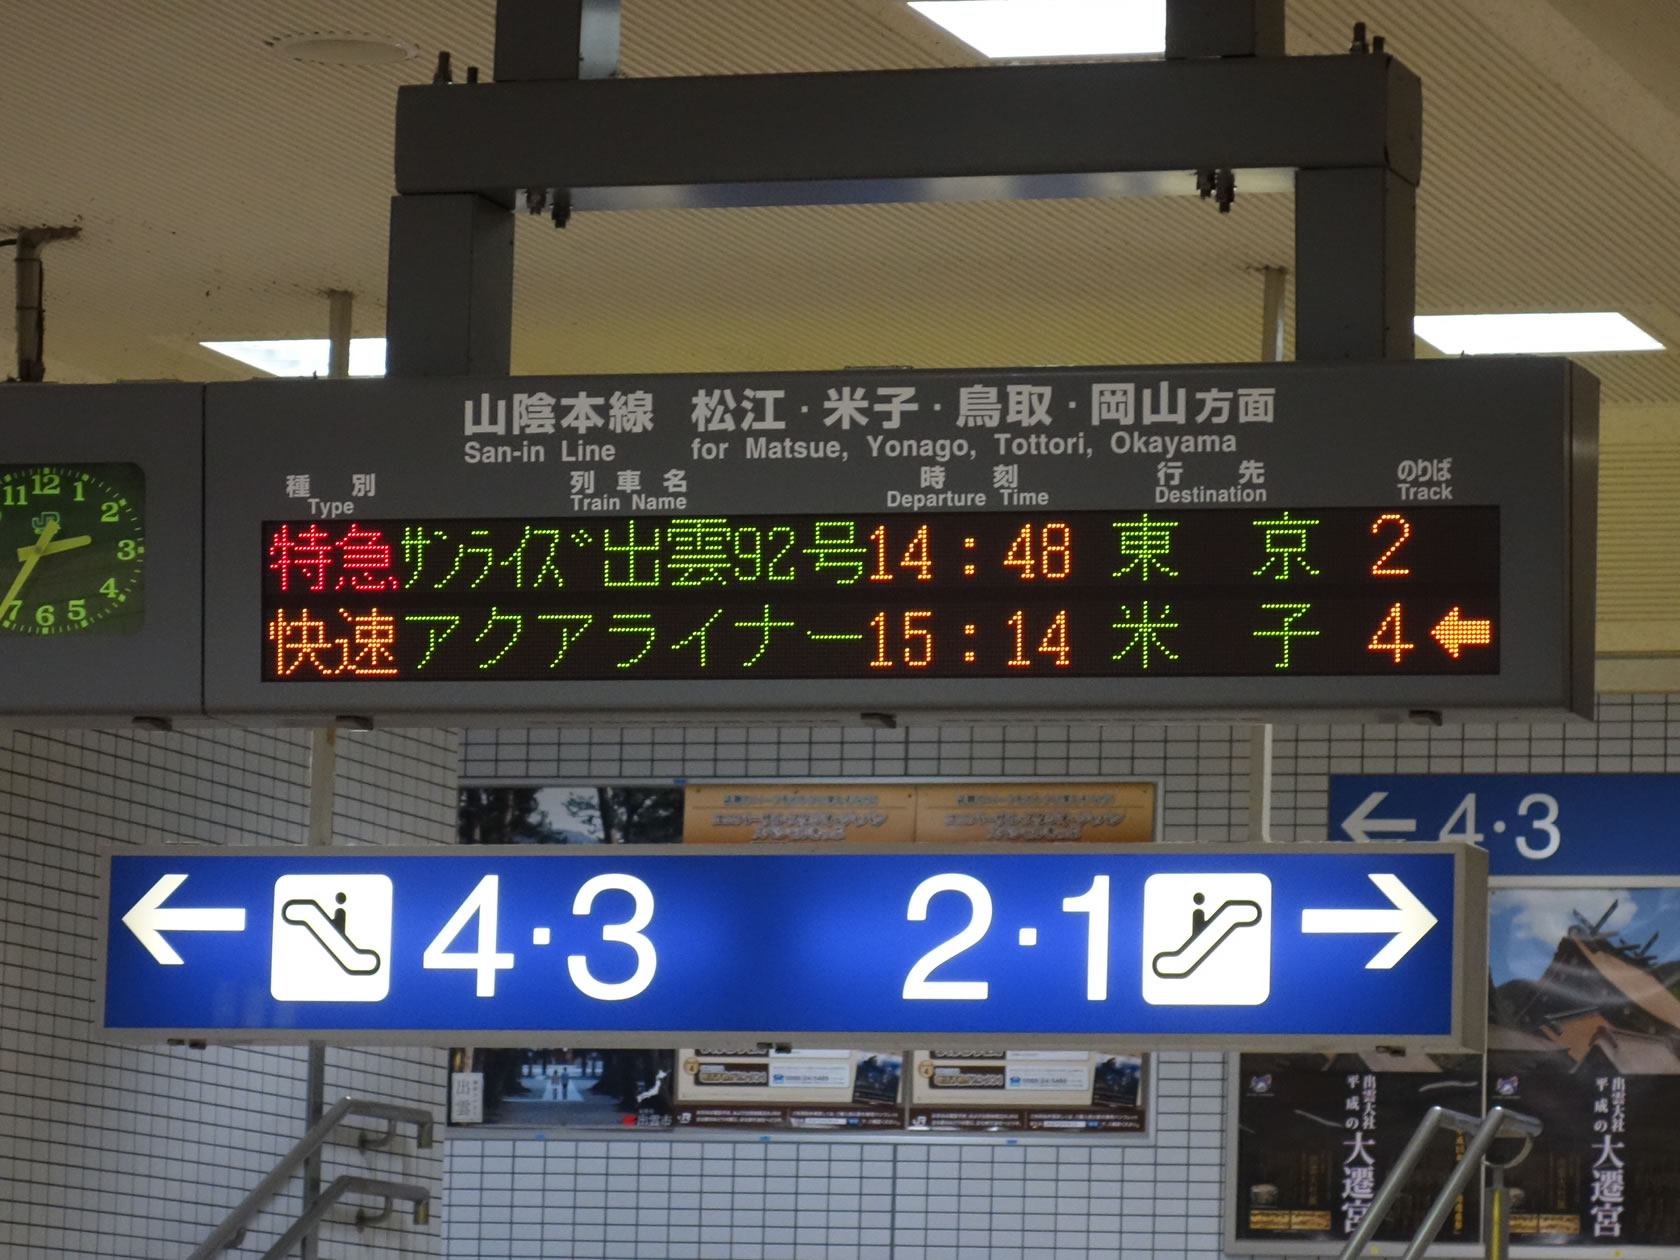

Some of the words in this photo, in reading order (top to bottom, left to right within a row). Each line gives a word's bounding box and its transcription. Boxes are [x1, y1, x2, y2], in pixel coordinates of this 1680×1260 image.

[464, 390, 655, 435] 山陰本線
[464, 440, 545, 464] San-in
[561, 440, 616, 462] Line
[691, 437, 728, 460] for
[746, 437, 849, 462] Matsue,
[867, 435, 977, 460] Yonago,
[994, 432, 1094, 458] Tottori,
[1110, 431, 1238, 457] Okayama
[1397, 458, 1453, 482] のりば
[3, 485, 28, 505] 11
[31, 474, 61, 495] 12
[73, 481, 85, 501] 1
[1397, 484, 1454, 502] Track
[571, 494, 620, 511] Train
[632, 493, 688, 510] Name
[887, 490, 986, 511] Departure
[1000, 489, 1049, 506] Time
[1155, 487, 1268, 506] Destination
[100, 502, 120, 522] 2
[308, 499, 354, 518] Type
[116, 539, 136, 560] 3
[269, 523, 398, 591] 特急
[1372, 513, 1410, 575] 2
[99, 577, 119, 598] 4
[9, 599, 23, 621] 7
[35, 605, 55, 626] 6
[67, 599, 87, 620] 5
[269, 607, 398, 675] 快速
[405, 603, 863, 670] アクアライナー
[1368, 602, 1414, 663] 4
[1362, 1075, 1377, 1130] 出雲大社
[1612, 1077, 1626, 1133] 出雲大社
